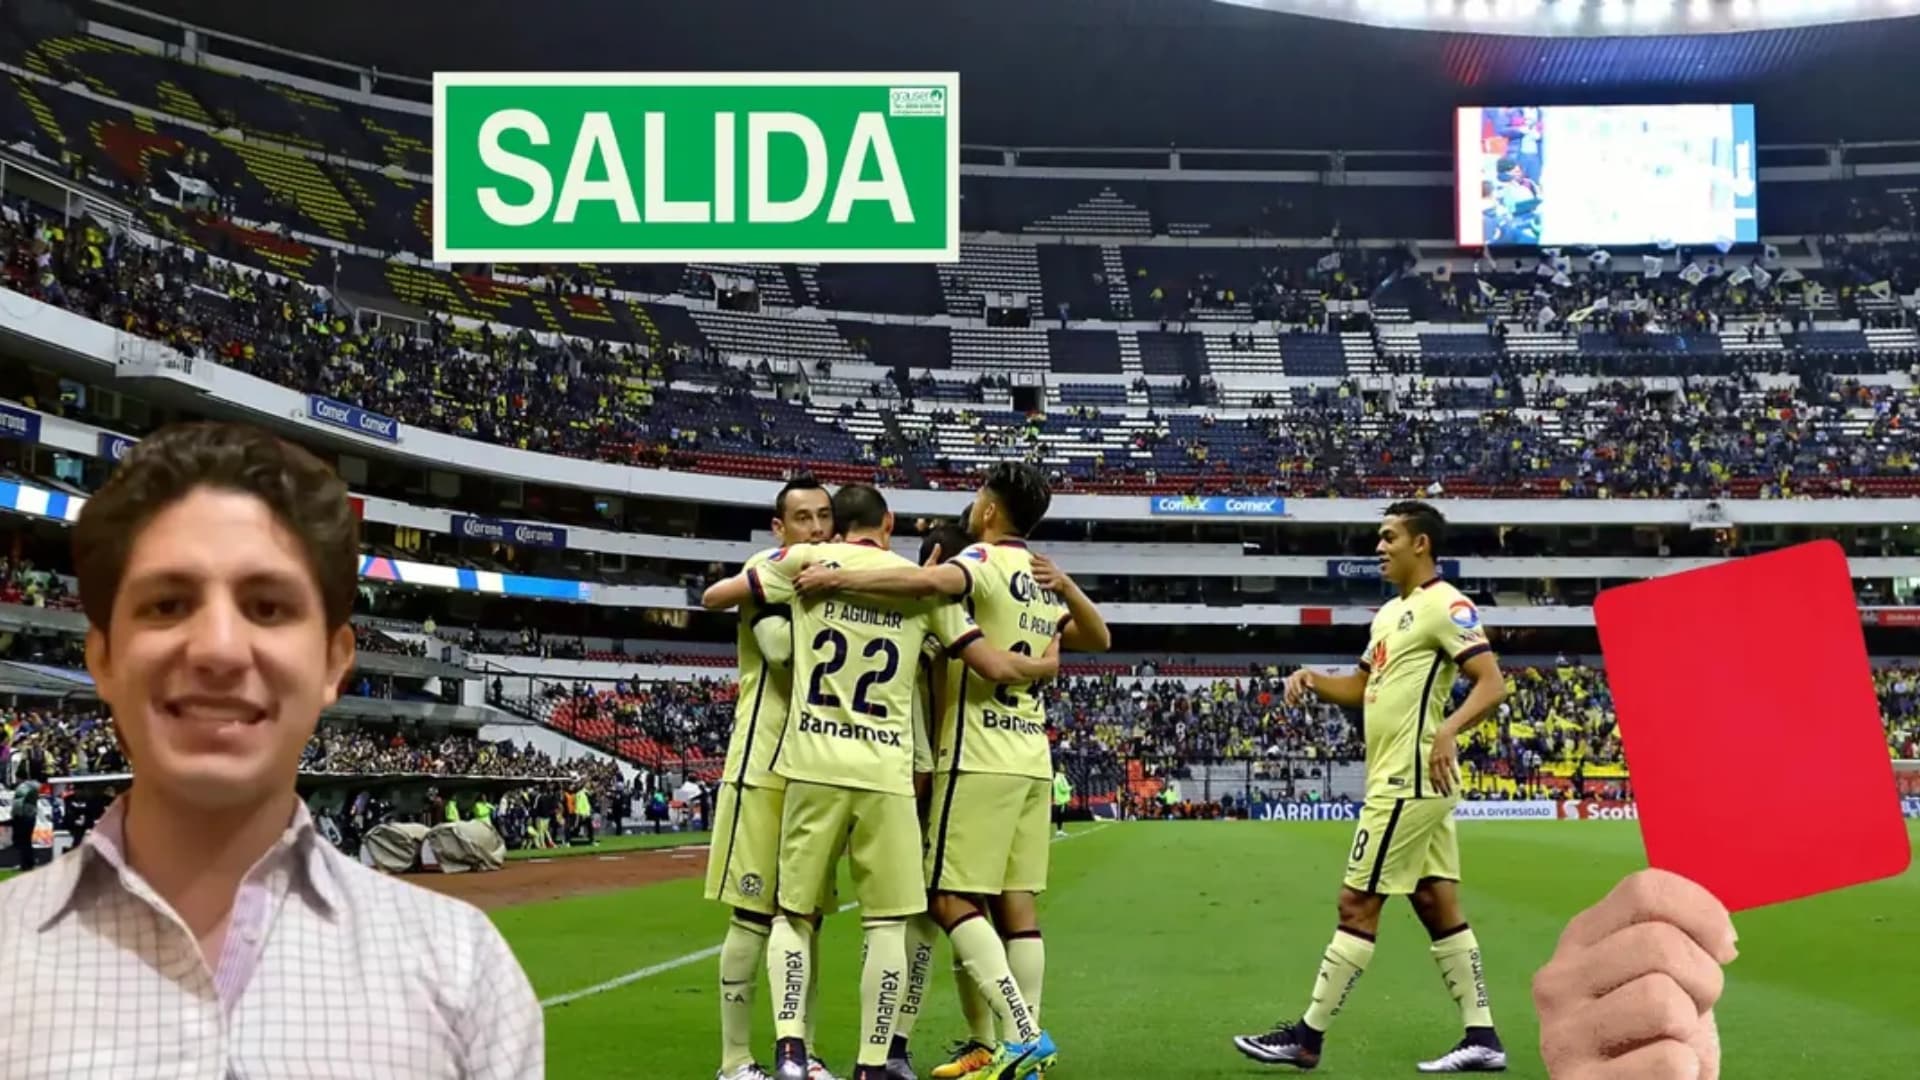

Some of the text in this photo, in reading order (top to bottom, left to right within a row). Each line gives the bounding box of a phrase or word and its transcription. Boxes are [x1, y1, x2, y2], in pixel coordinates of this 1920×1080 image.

[316, 401, 393, 436] Comex Comex
[1225, 498, 1277, 512] Comex
[463, 519, 554, 543] Corona Corona
[824, 602, 903, 629] P. AGUILAR
[807, 628, 899, 718] 22
[799, 711, 900, 747] Banamex
[1260, 803, 1355, 820] JARRITOS
[1472, 808, 1485, 817] LA
[1487, 808, 1549, 817] DIVERSIDAD
[1352, 829, 1369, 861] 8
[777, 950, 804, 1021] Banamex
[899, 943, 932, 1015] Banamex
[869, 970, 900, 1045] Banamex
